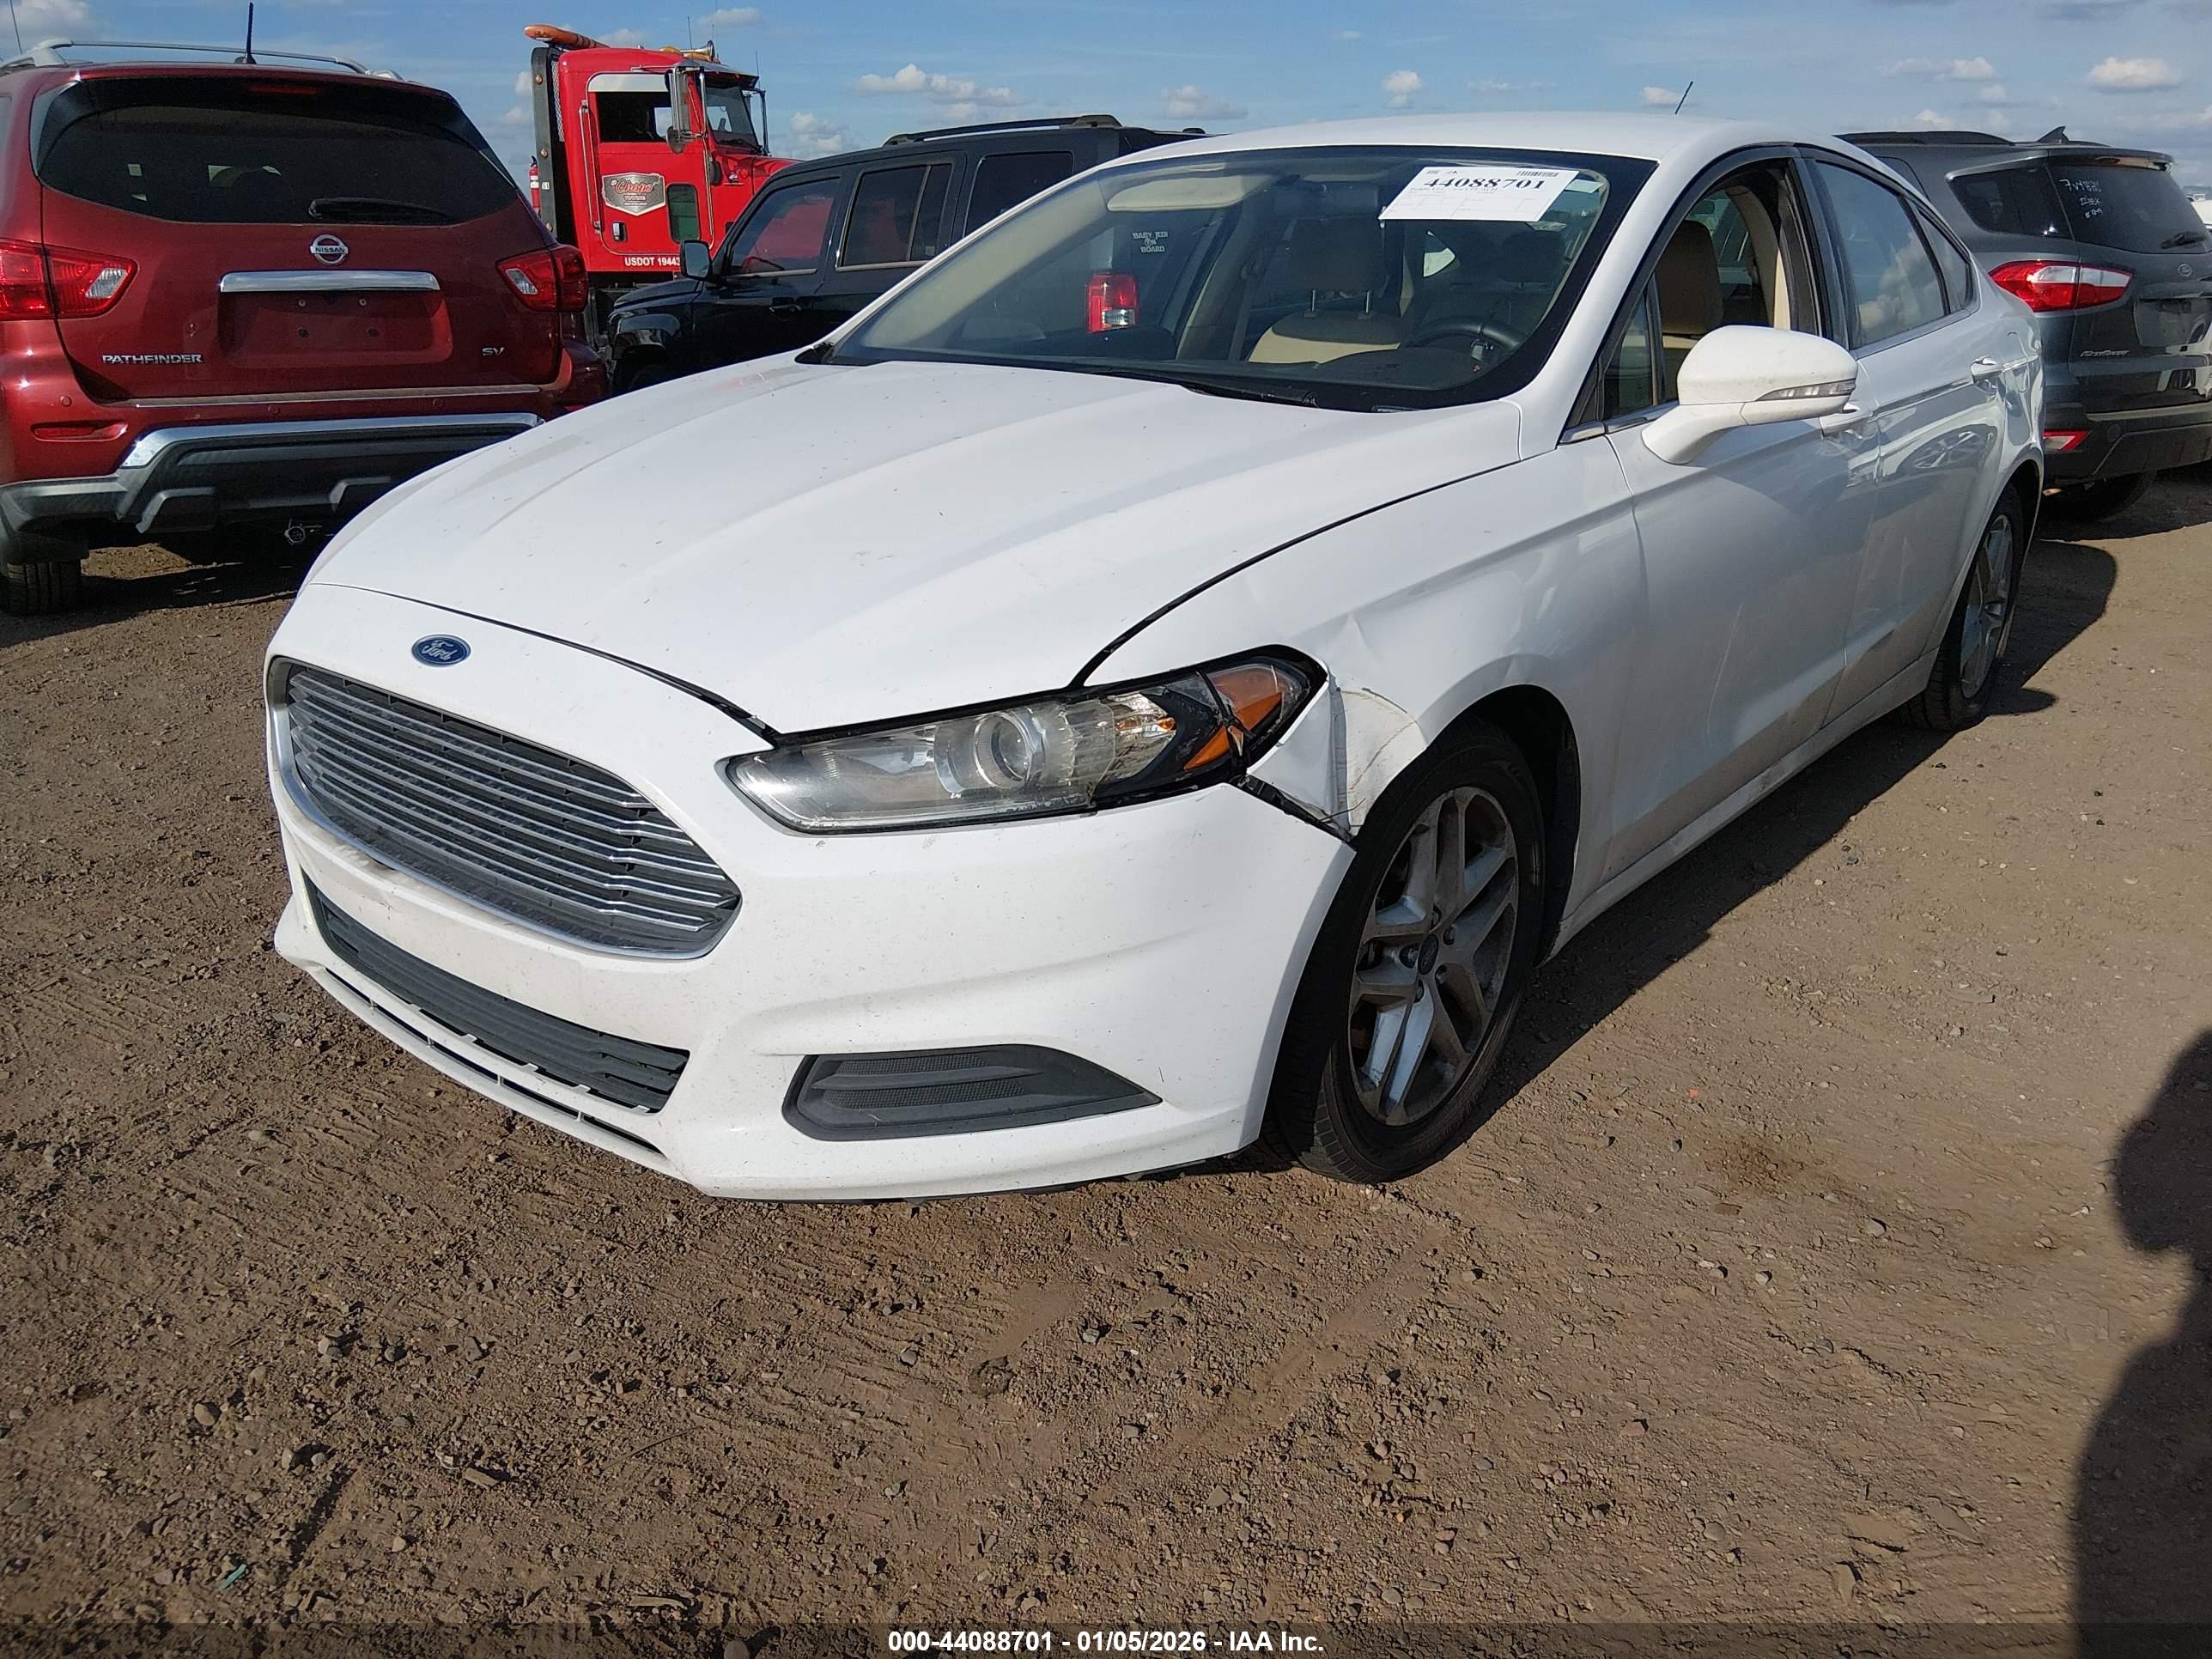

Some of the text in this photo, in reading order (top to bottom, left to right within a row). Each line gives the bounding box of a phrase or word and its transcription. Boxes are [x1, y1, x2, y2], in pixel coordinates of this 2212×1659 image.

[1424, 178, 1547, 189] 44088701
[624, 257, 655, 267] USDOT
[482, 347, 505, 356] SV
[102, 354, 204, 365] PATHFINDER
